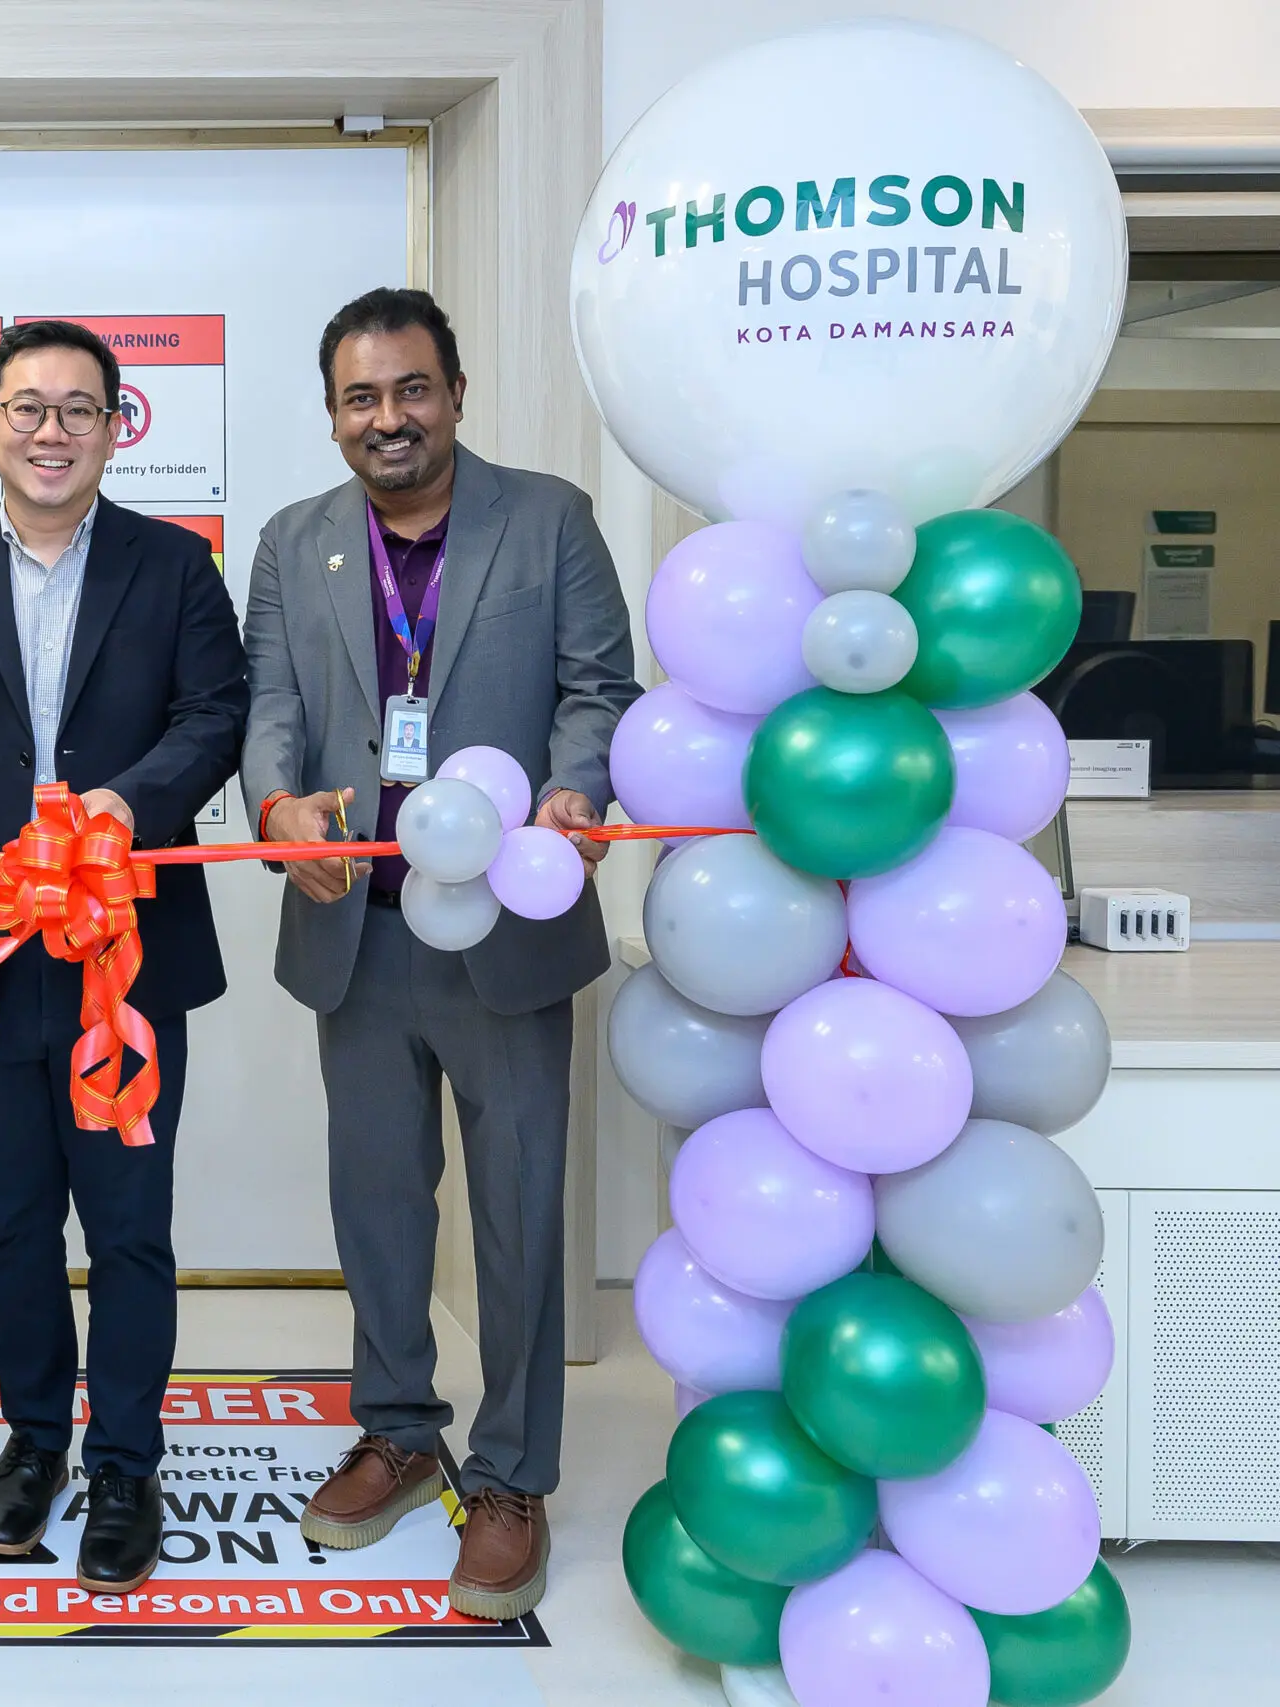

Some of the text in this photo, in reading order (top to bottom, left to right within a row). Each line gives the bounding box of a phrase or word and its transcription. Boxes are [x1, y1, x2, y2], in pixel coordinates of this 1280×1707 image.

[646, 174, 1025, 258] THOMSON
[738, 246, 1022, 306] HOSPITAL
[736, 320, 1015, 345] KOTA DAMANSARA
[115, 465, 147, 477] entry
[150, 464, 207, 475] forbidden
[161, 1443, 278, 1461] trong
[158, 1529, 279, 1565] ON
[56, 1586, 303, 1615] Personal
[319, 1587, 452, 1621] Only
